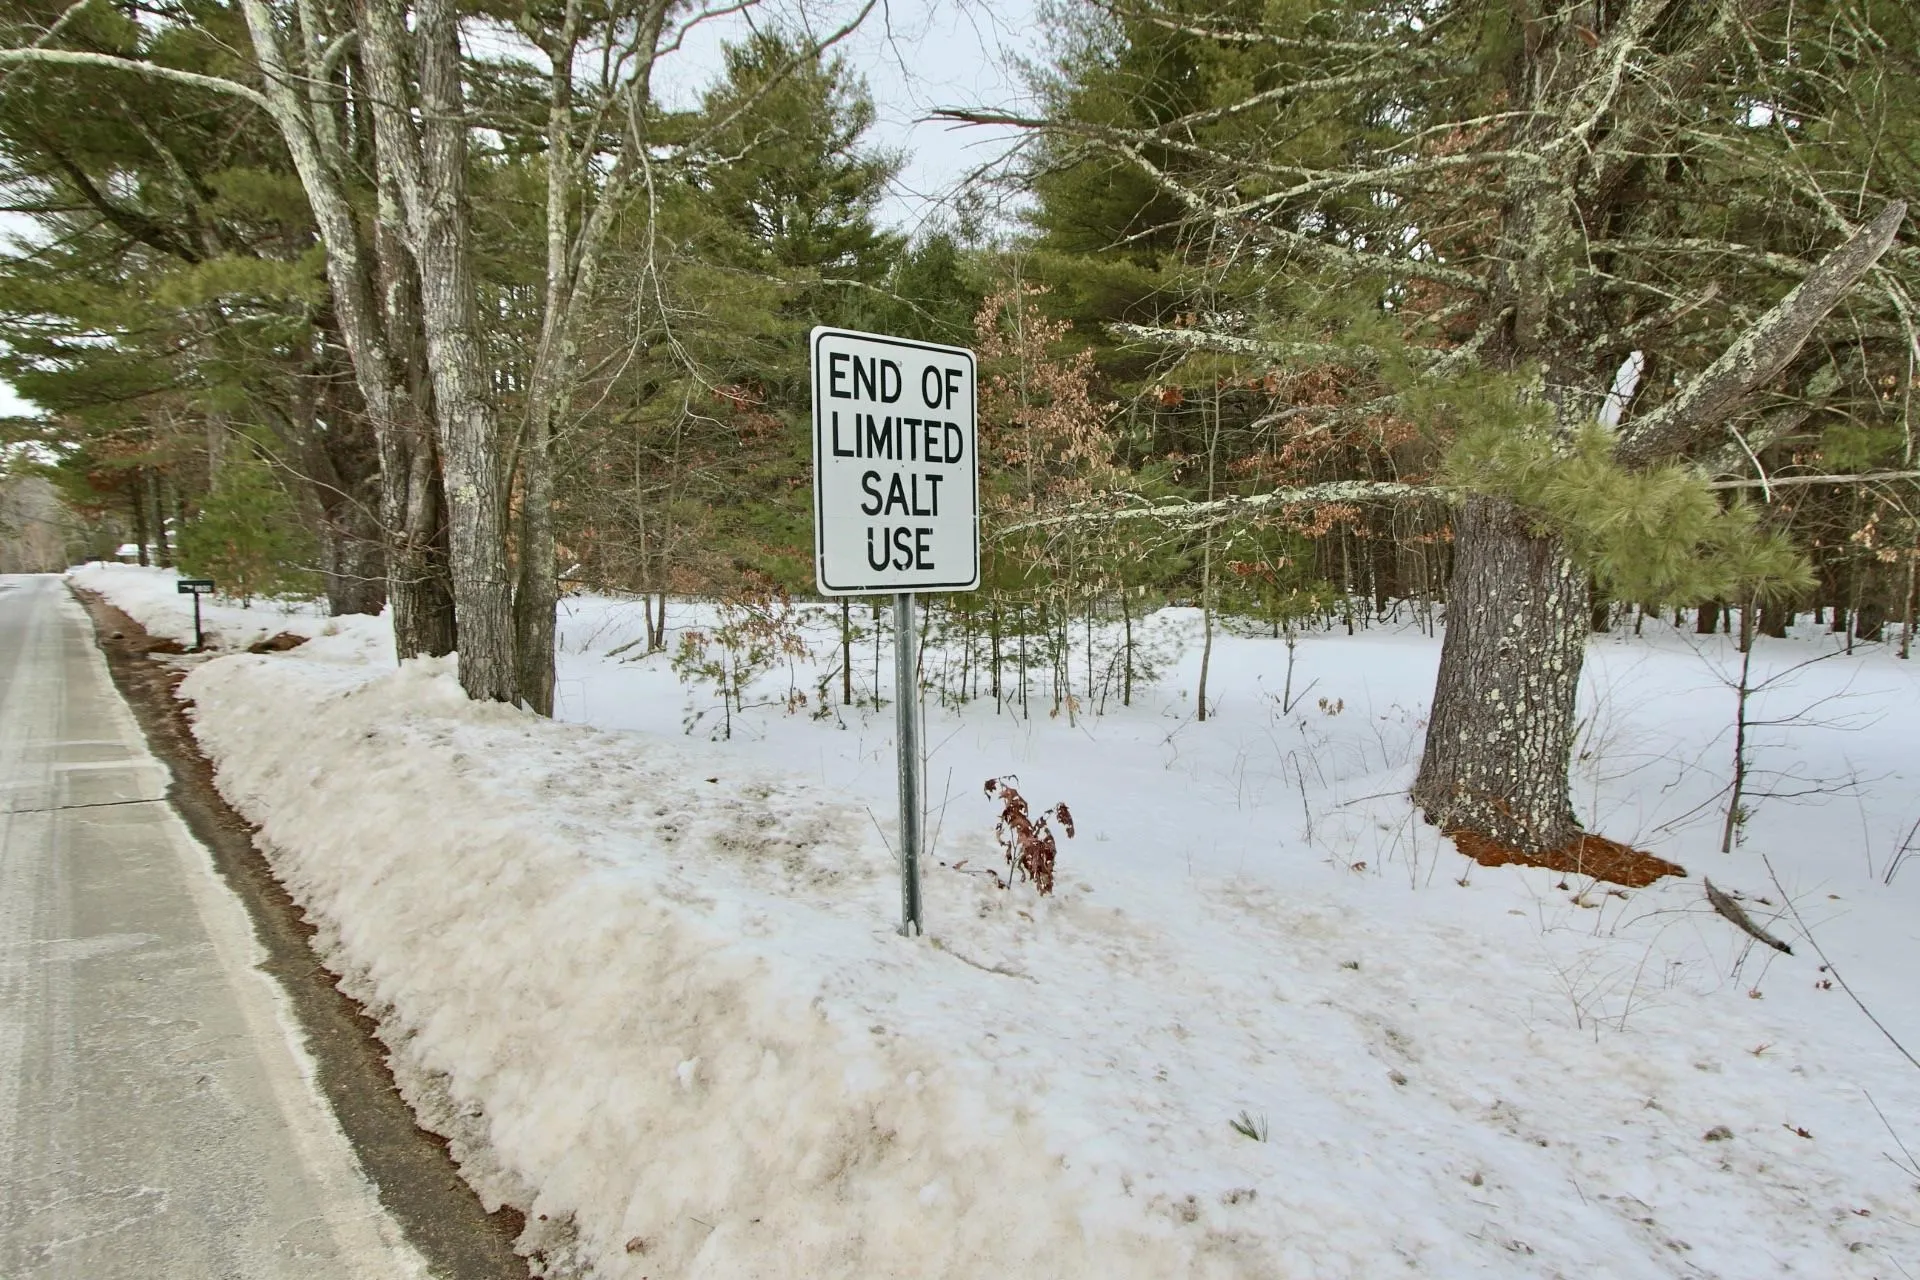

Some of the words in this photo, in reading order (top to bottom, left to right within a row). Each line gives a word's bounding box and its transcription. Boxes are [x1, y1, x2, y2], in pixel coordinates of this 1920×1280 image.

[830, 352, 902, 404] END
[922, 365, 963, 410] OF
[832, 411, 964, 464] LIMITED
[861, 470, 944, 516] SALT
[867, 526, 935, 571] USE
